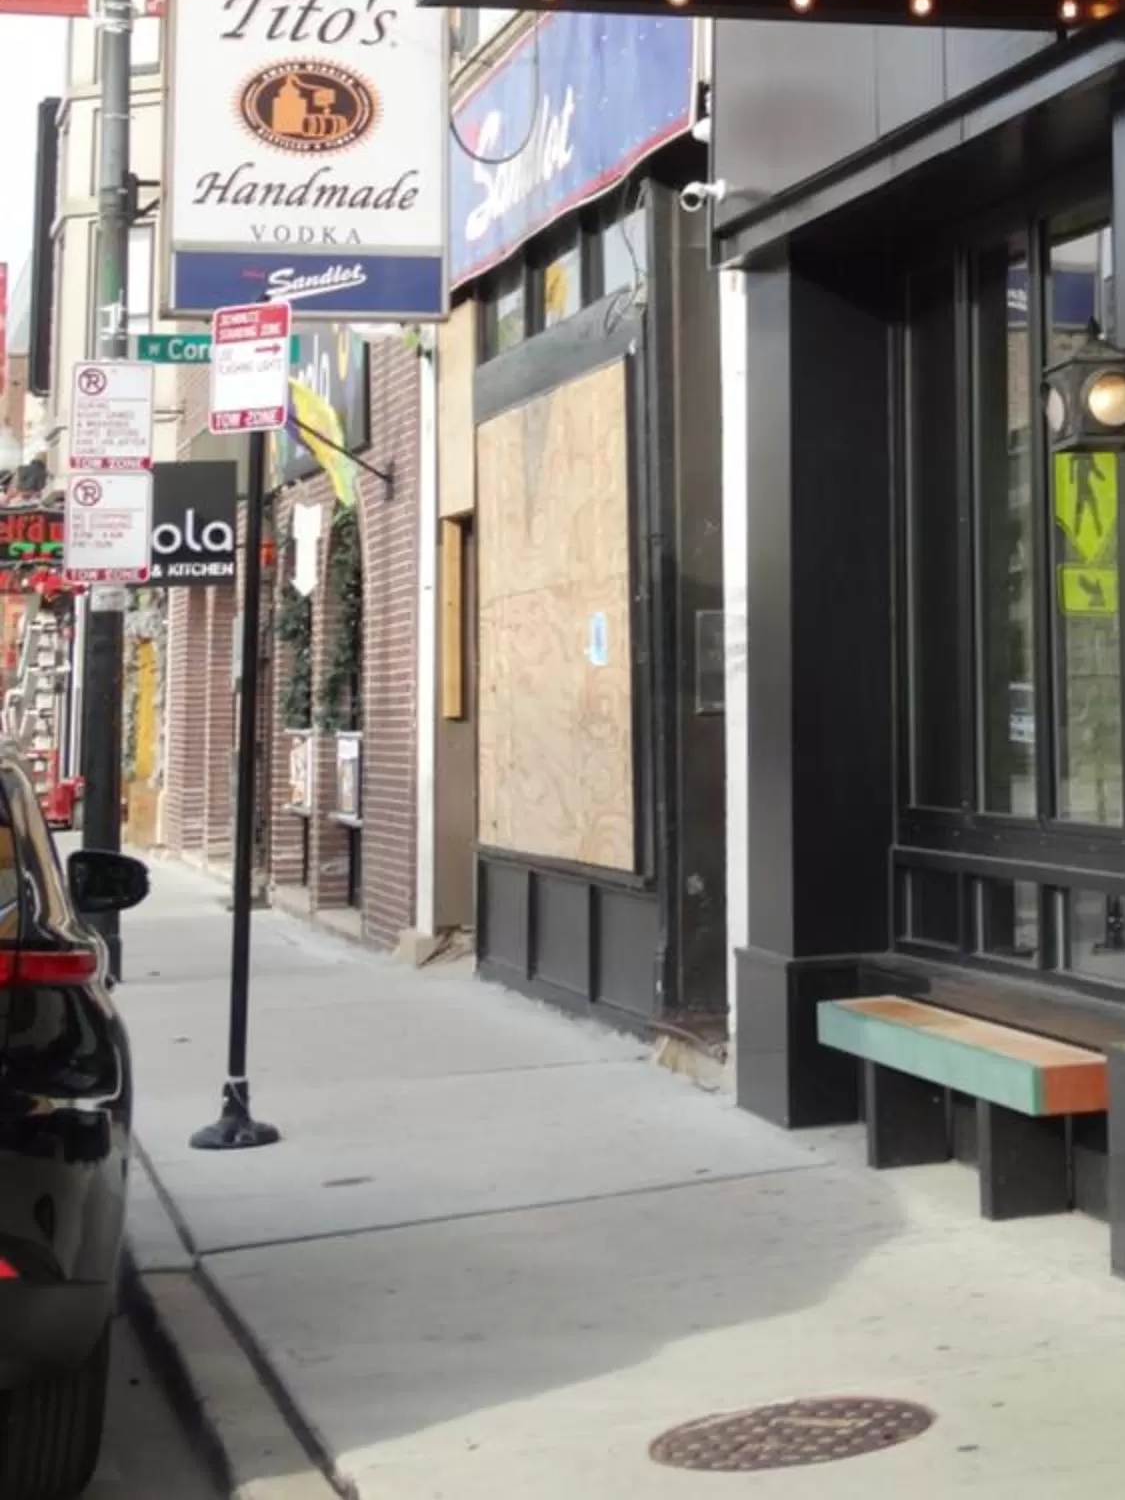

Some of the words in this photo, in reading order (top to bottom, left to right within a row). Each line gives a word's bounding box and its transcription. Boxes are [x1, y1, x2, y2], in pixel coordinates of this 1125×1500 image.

[192, 161, 420, 211] Handmade
[250, 223, 362, 245] VODKA
[167, 561, 234, 578] KITCHEN
